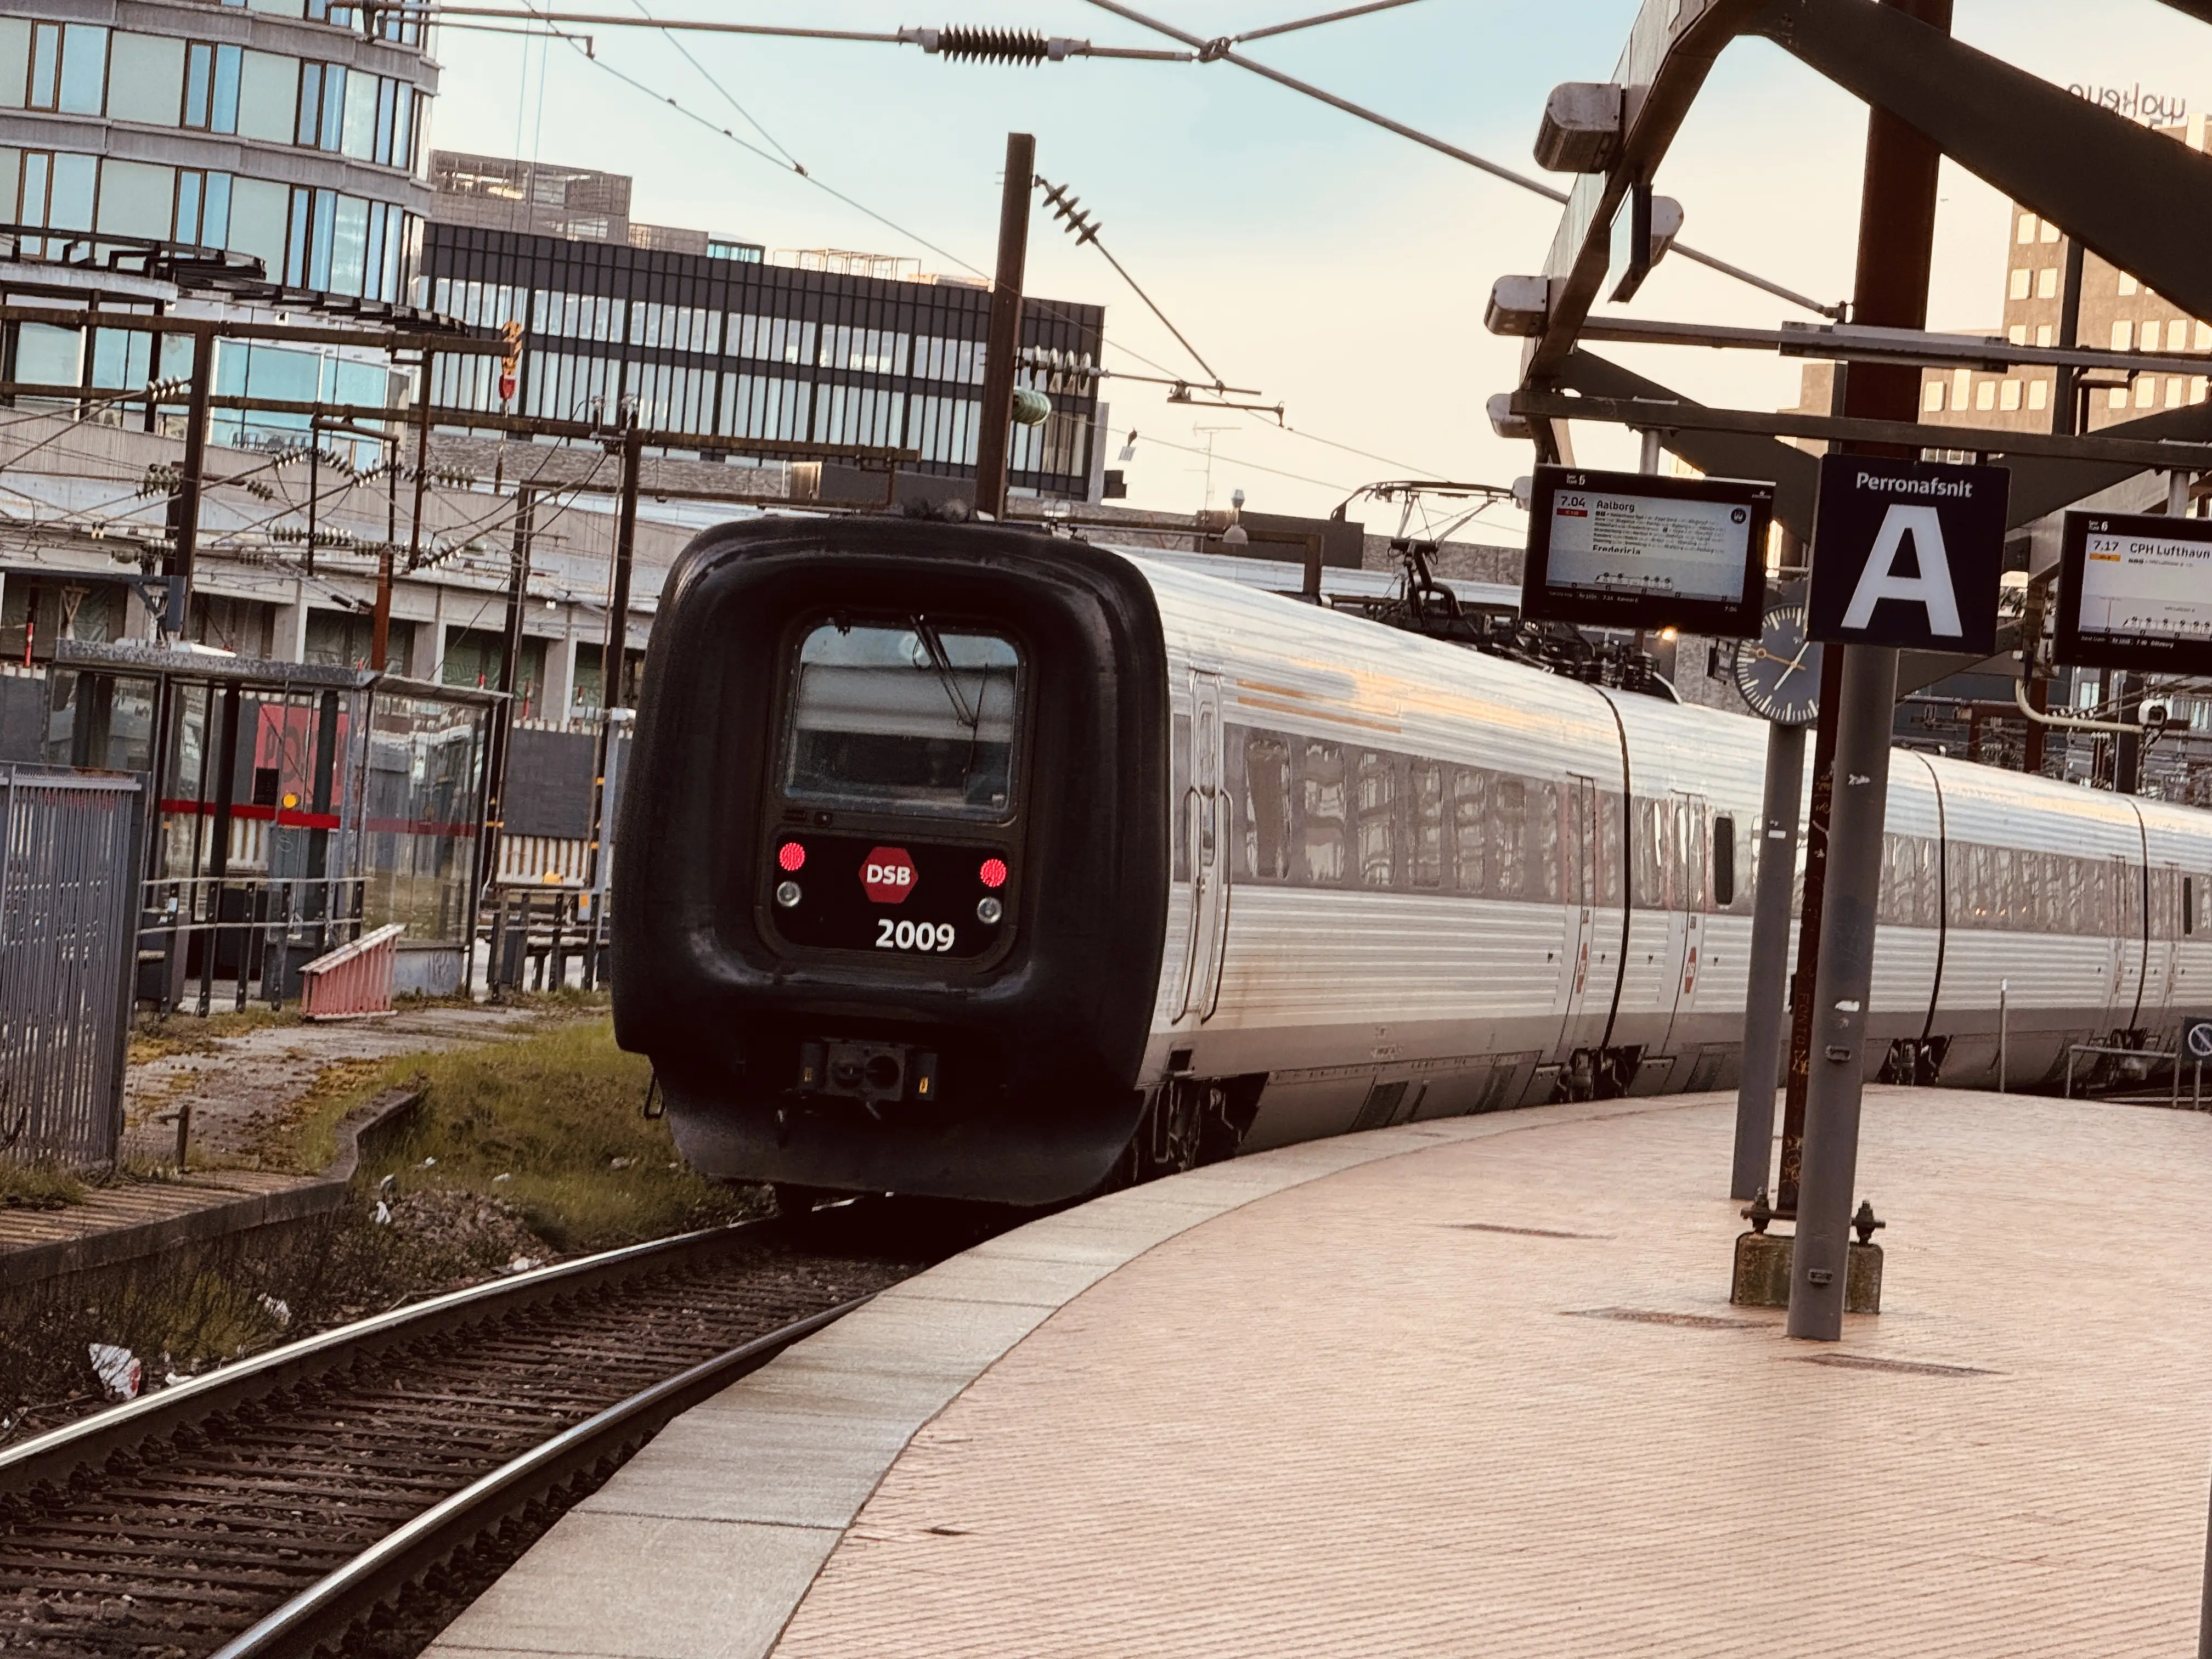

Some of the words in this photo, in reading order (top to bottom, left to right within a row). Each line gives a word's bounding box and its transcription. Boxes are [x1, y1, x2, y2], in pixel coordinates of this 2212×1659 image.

[1857, 472, 1973, 498] Perronafsnit
[1561, 496, 1585, 507] 7.04
[1596, 500, 1635, 513] Aalborg
[2130, 542, 2154, 554] CPH
[2157, 545, 2210, 559] Lufthavn
[1841, 504, 1963, 637] A
[866, 864, 911, 885] DSB
[876, 918, 955, 952] 2009
